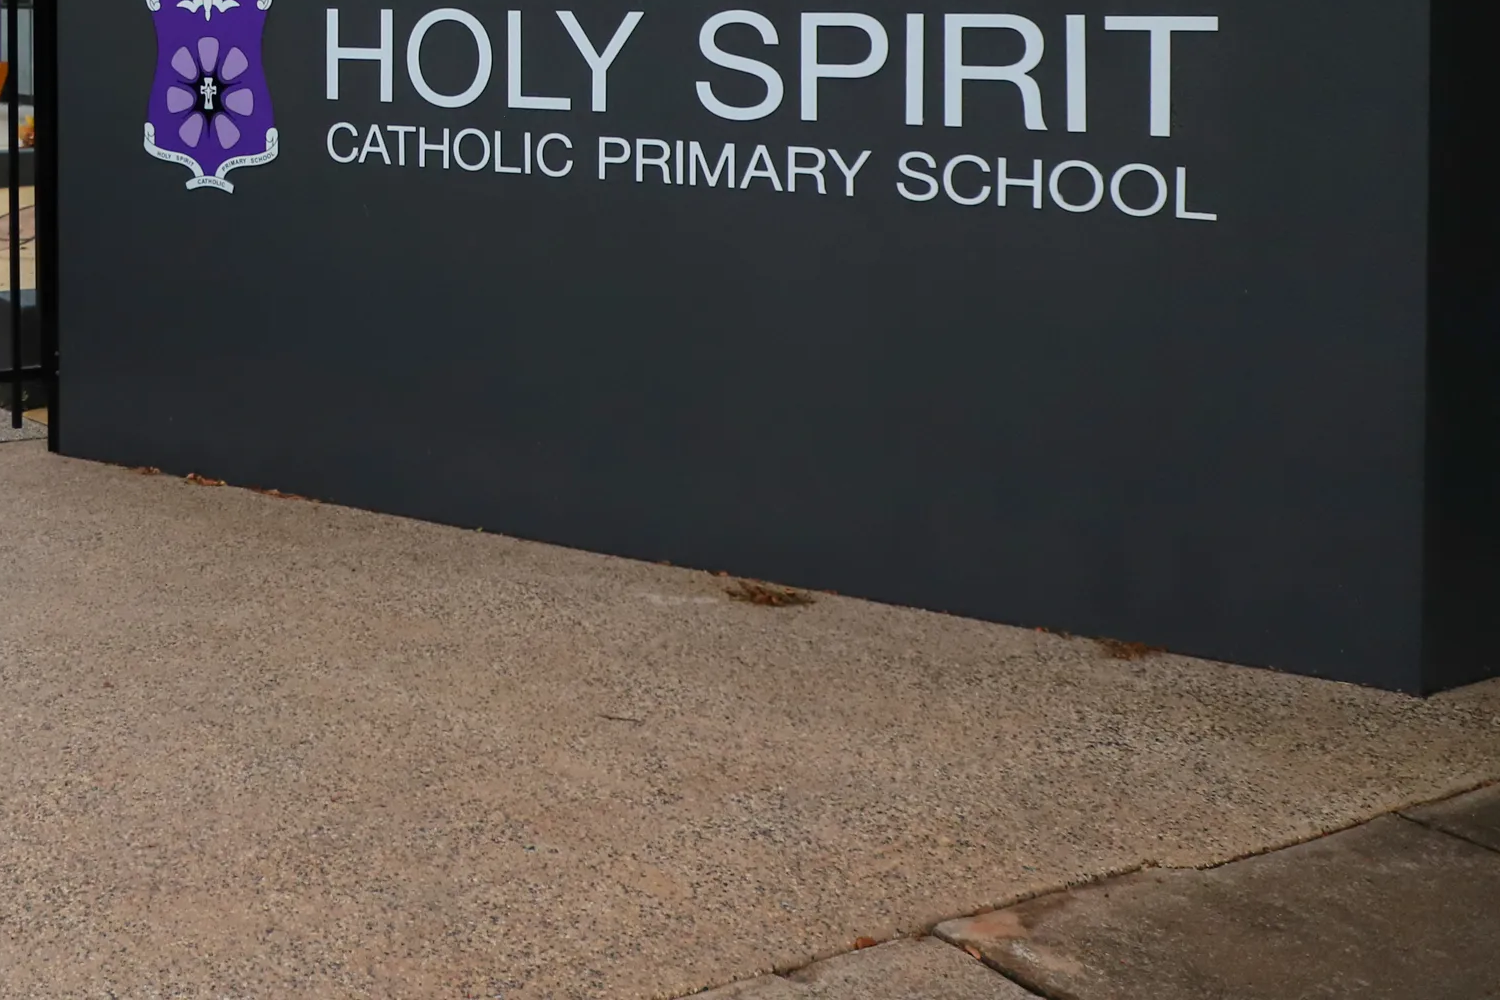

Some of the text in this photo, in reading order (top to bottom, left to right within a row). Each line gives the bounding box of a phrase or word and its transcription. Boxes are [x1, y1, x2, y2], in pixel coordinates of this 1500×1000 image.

[327, 7, 1219, 137] HOLY SPIRIT
[157, 151, 275, 188] HOLY SPIRIT CATHOLIC PRIMARY SCHOOL
[326, 121, 1217, 221] CATHOLIC PRIMARY SCHOOL
